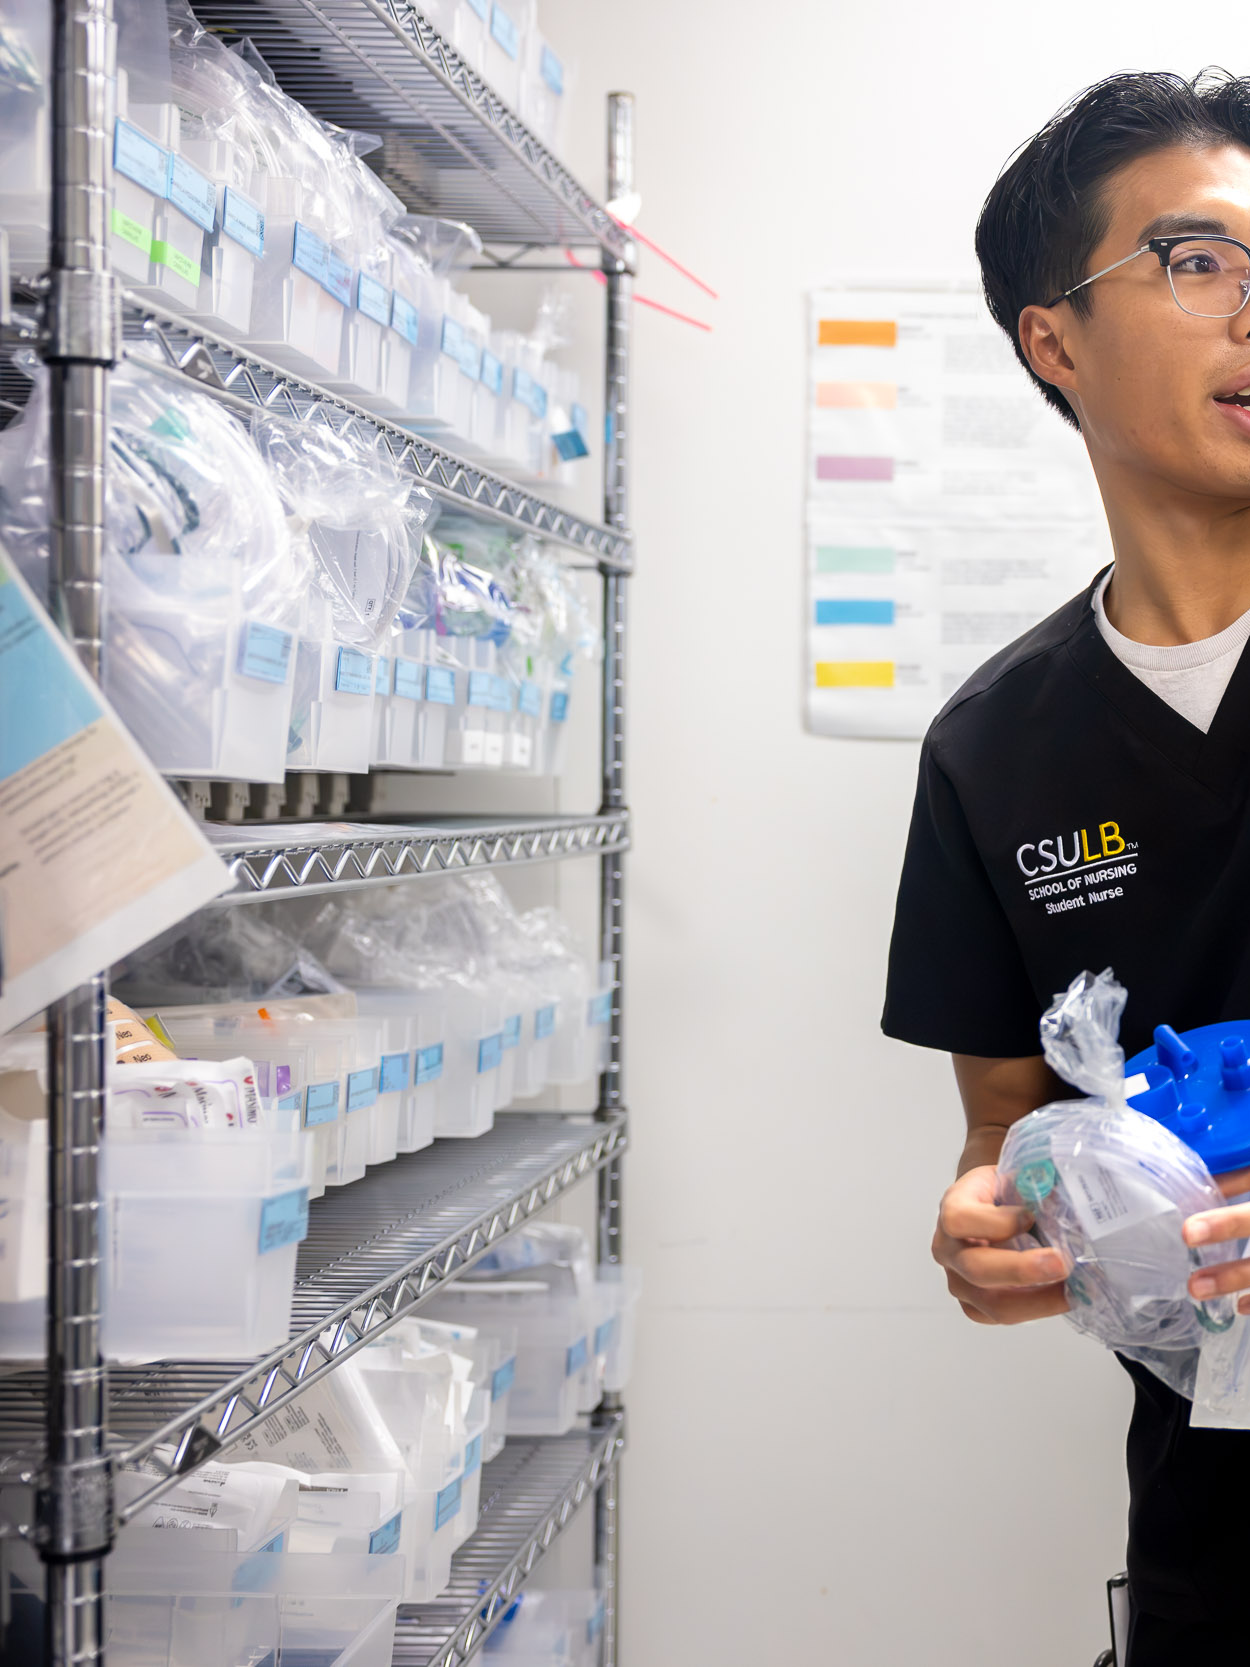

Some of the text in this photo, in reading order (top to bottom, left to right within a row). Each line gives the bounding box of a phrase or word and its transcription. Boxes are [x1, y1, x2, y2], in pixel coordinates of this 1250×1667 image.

[1016, 821, 1125, 877] CSULB
[1028, 863, 1137, 901] SCHOOL OF NURSING
[1045, 886, 1124, 914] Student Nurse
[116, 1030, 133, 1039] Neo
[133, 1053, 152, 1063] Neo
